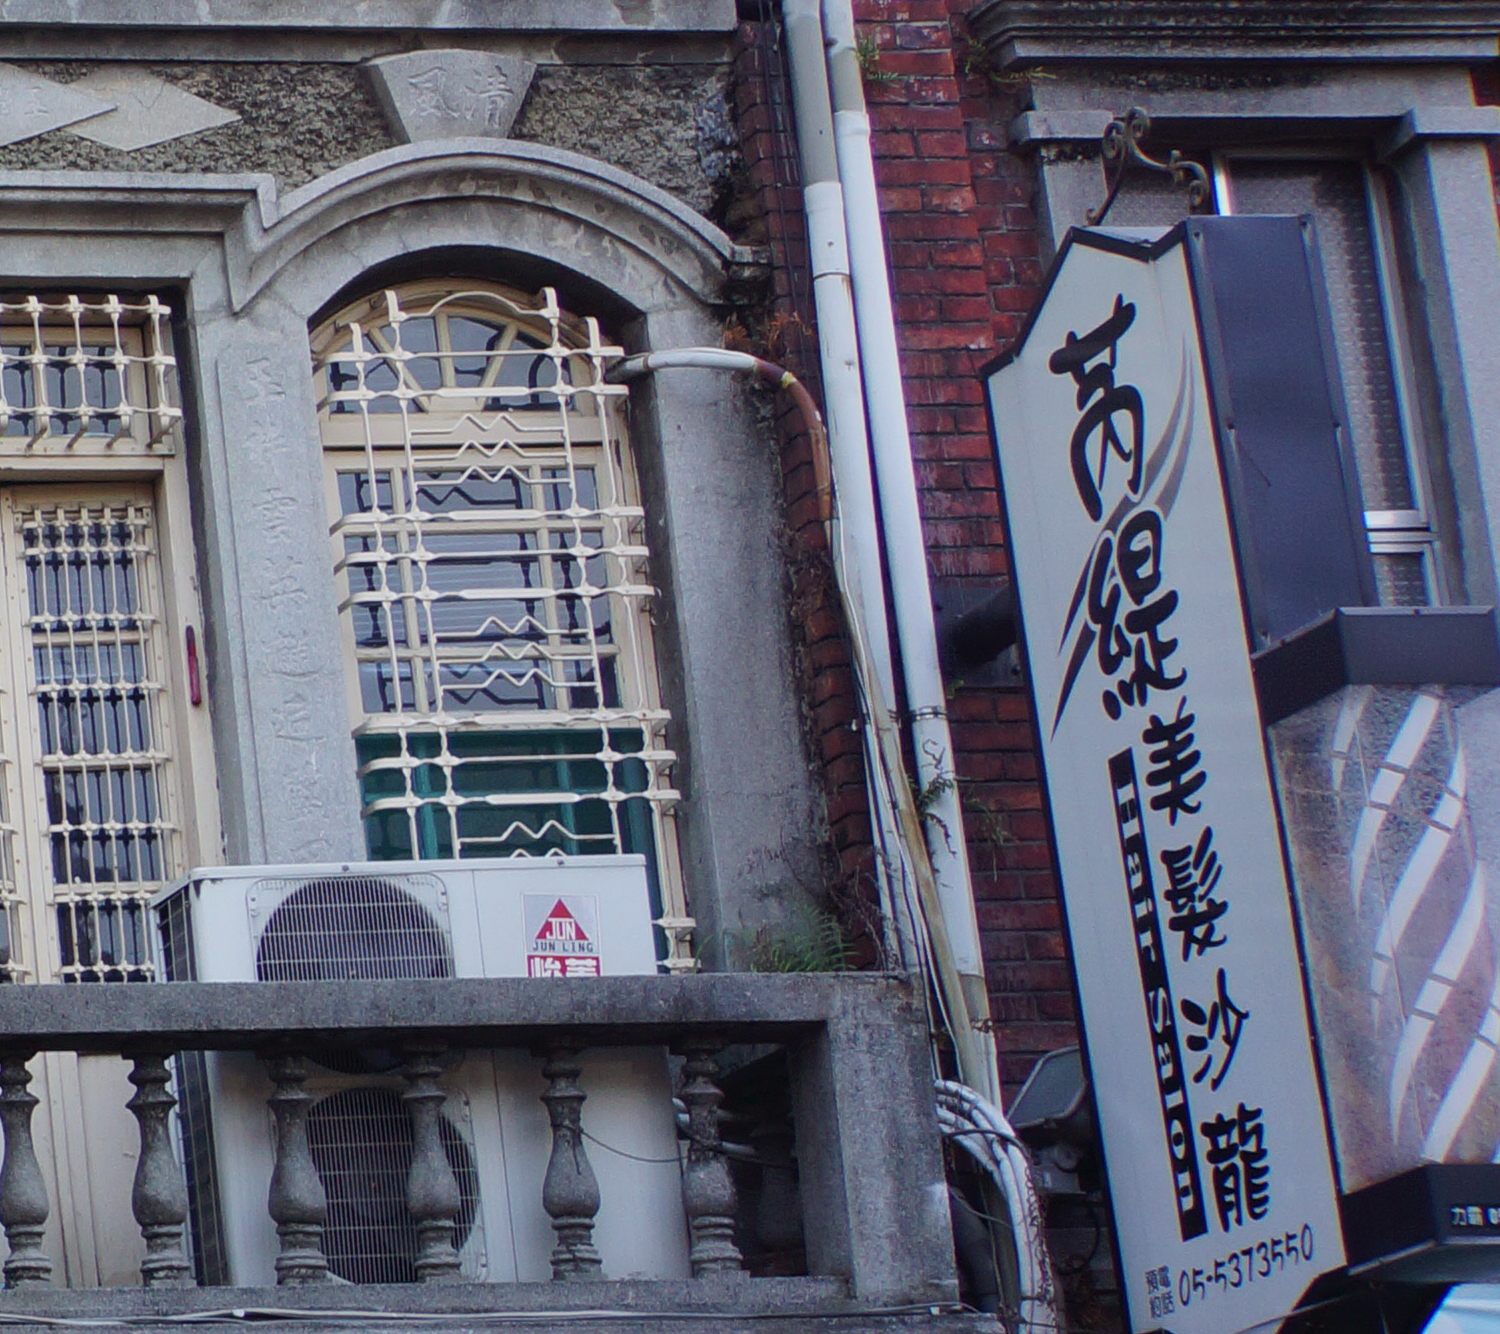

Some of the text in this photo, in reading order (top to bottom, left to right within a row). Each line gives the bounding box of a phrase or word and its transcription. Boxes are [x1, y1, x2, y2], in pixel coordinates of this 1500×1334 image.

[545, 917, 577, 940] JUN
[533, 941, 594, 953] JUN LING
